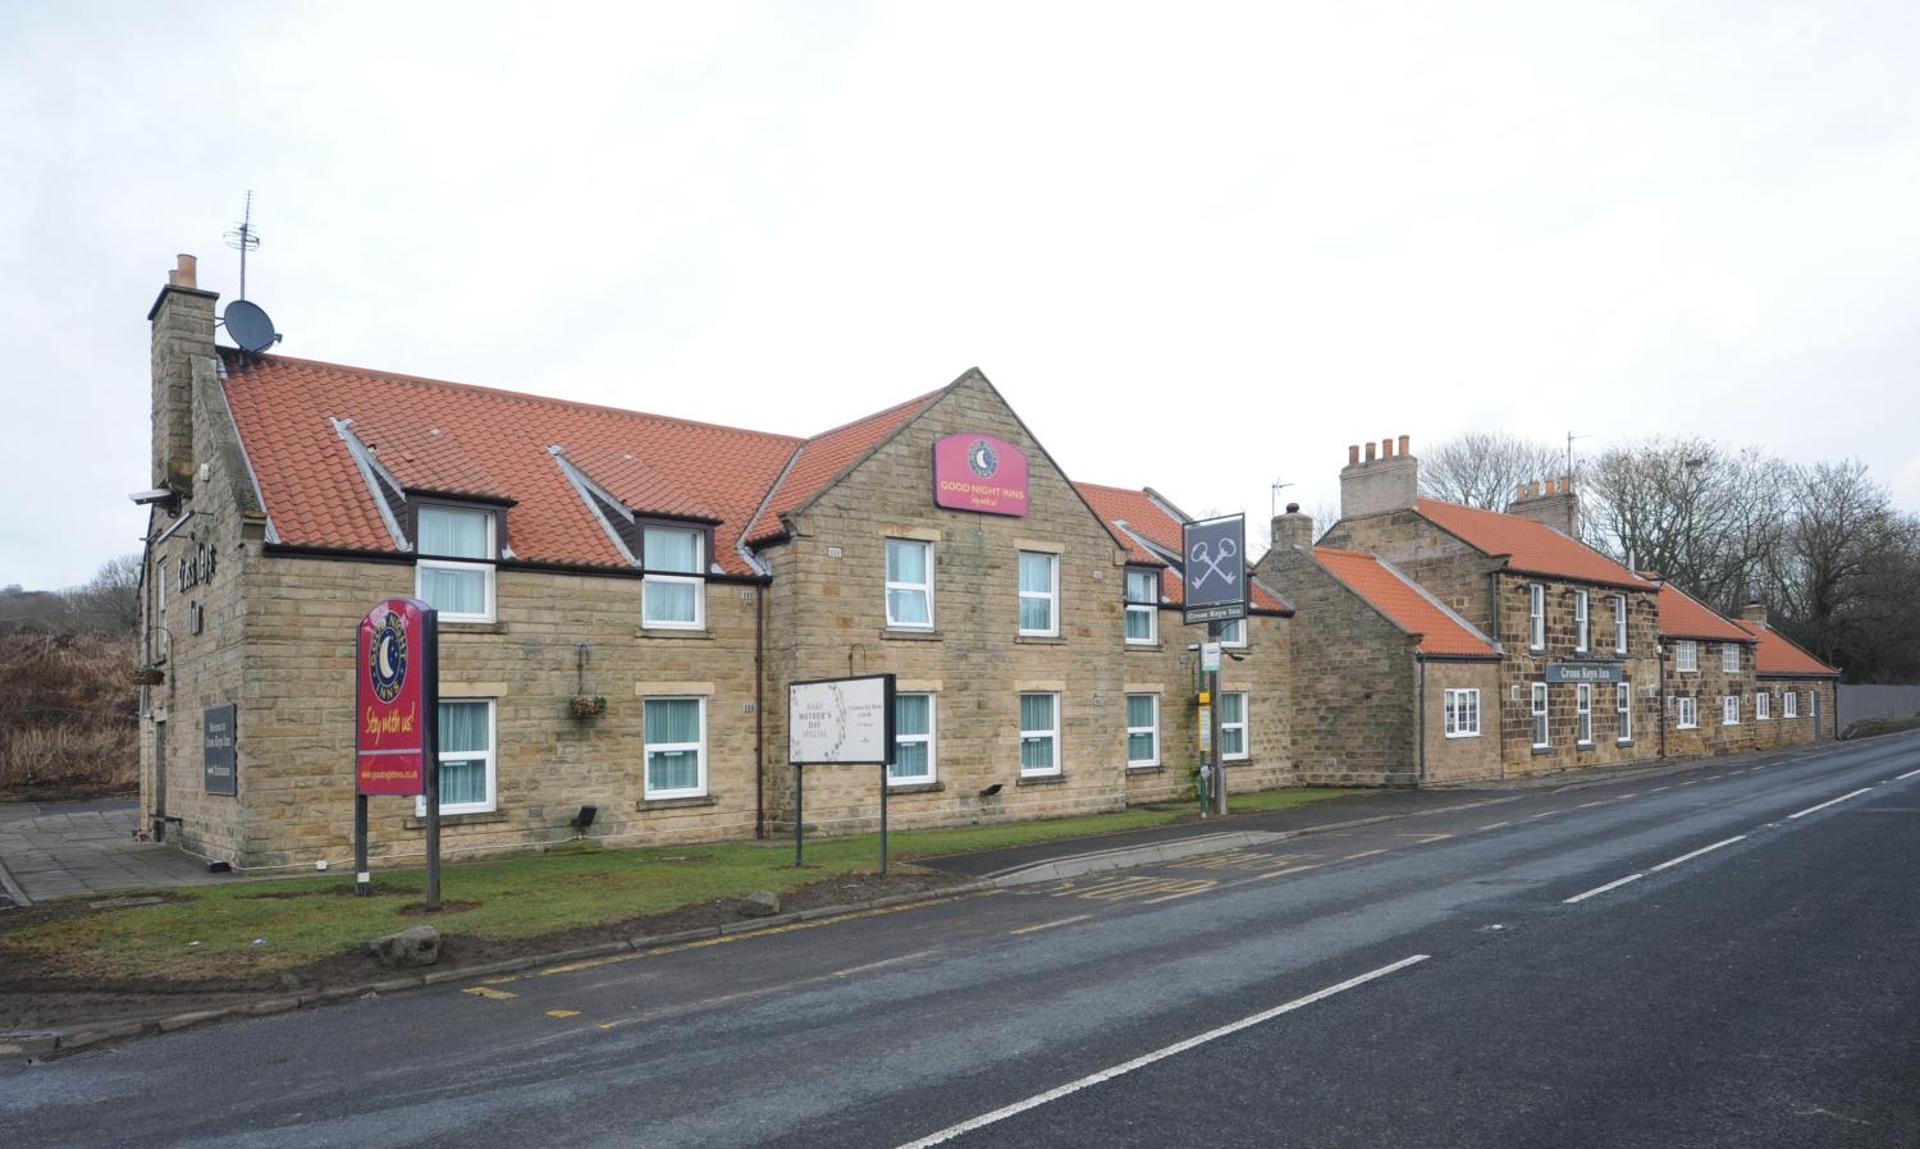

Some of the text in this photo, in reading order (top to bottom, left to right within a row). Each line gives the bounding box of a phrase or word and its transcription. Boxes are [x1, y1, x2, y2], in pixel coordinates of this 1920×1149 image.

[940, 480, 1025, 500] GOOD NIGHT INNS
[1561, 667, 1610, 682] Cross Keys Inn
[366, 700, 415, 746] Stay with us!
